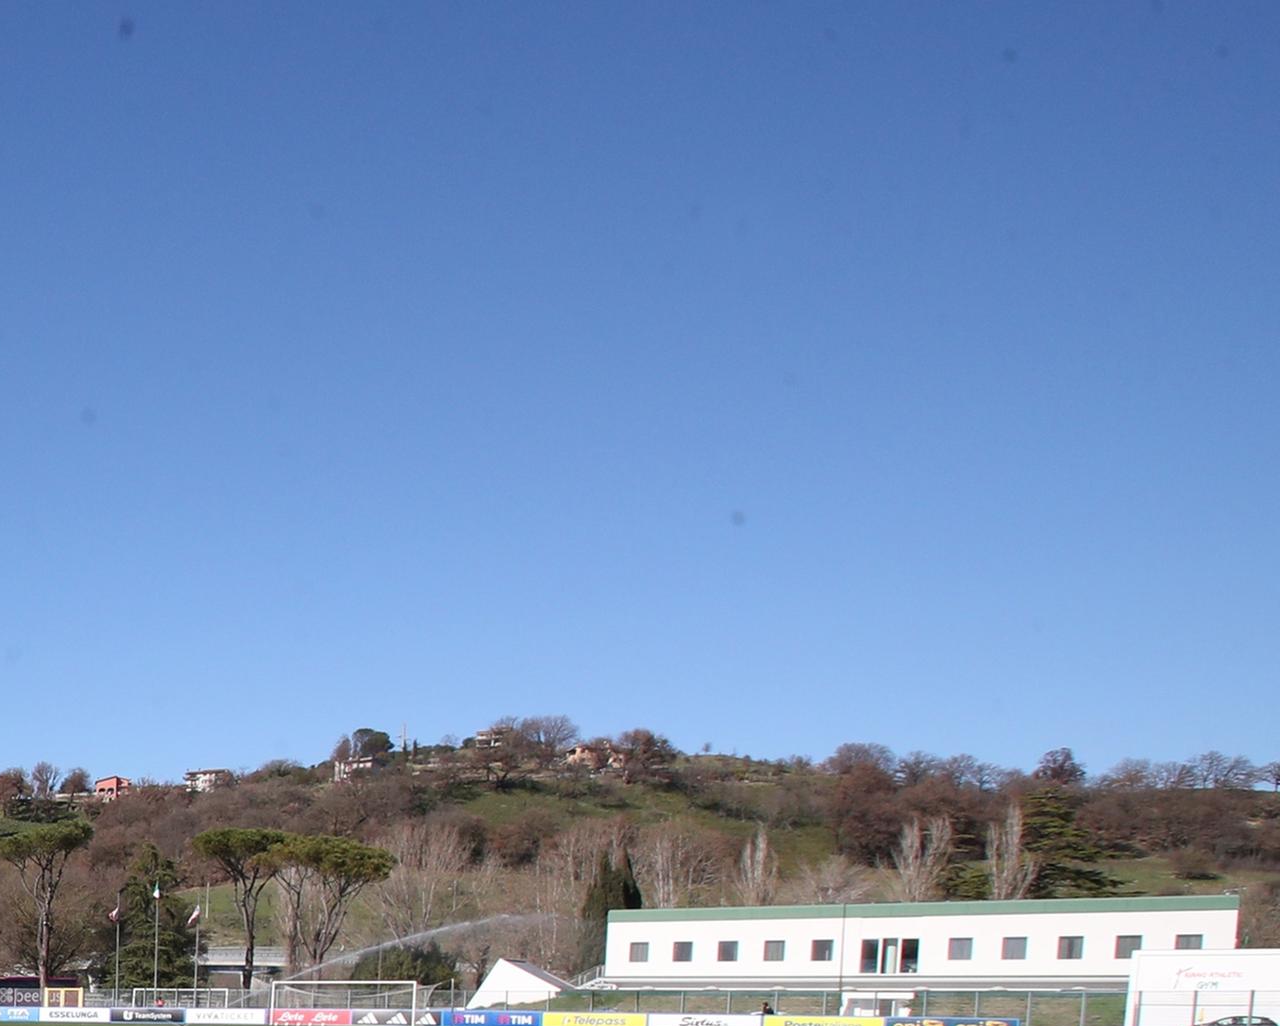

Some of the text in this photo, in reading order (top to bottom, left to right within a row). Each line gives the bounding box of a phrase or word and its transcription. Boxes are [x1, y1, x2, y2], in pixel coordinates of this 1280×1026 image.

[195, 1012, 254, 1020] VIVATICKET
[277, 1011, 304, 1021] Lete
[310, 1012, 338, 1022] Lete
[463, 1015, 485, 1025] TIM
[511, 1015, 533, 1025] TIM
[574, 1016, 626, 1026] Telepass
